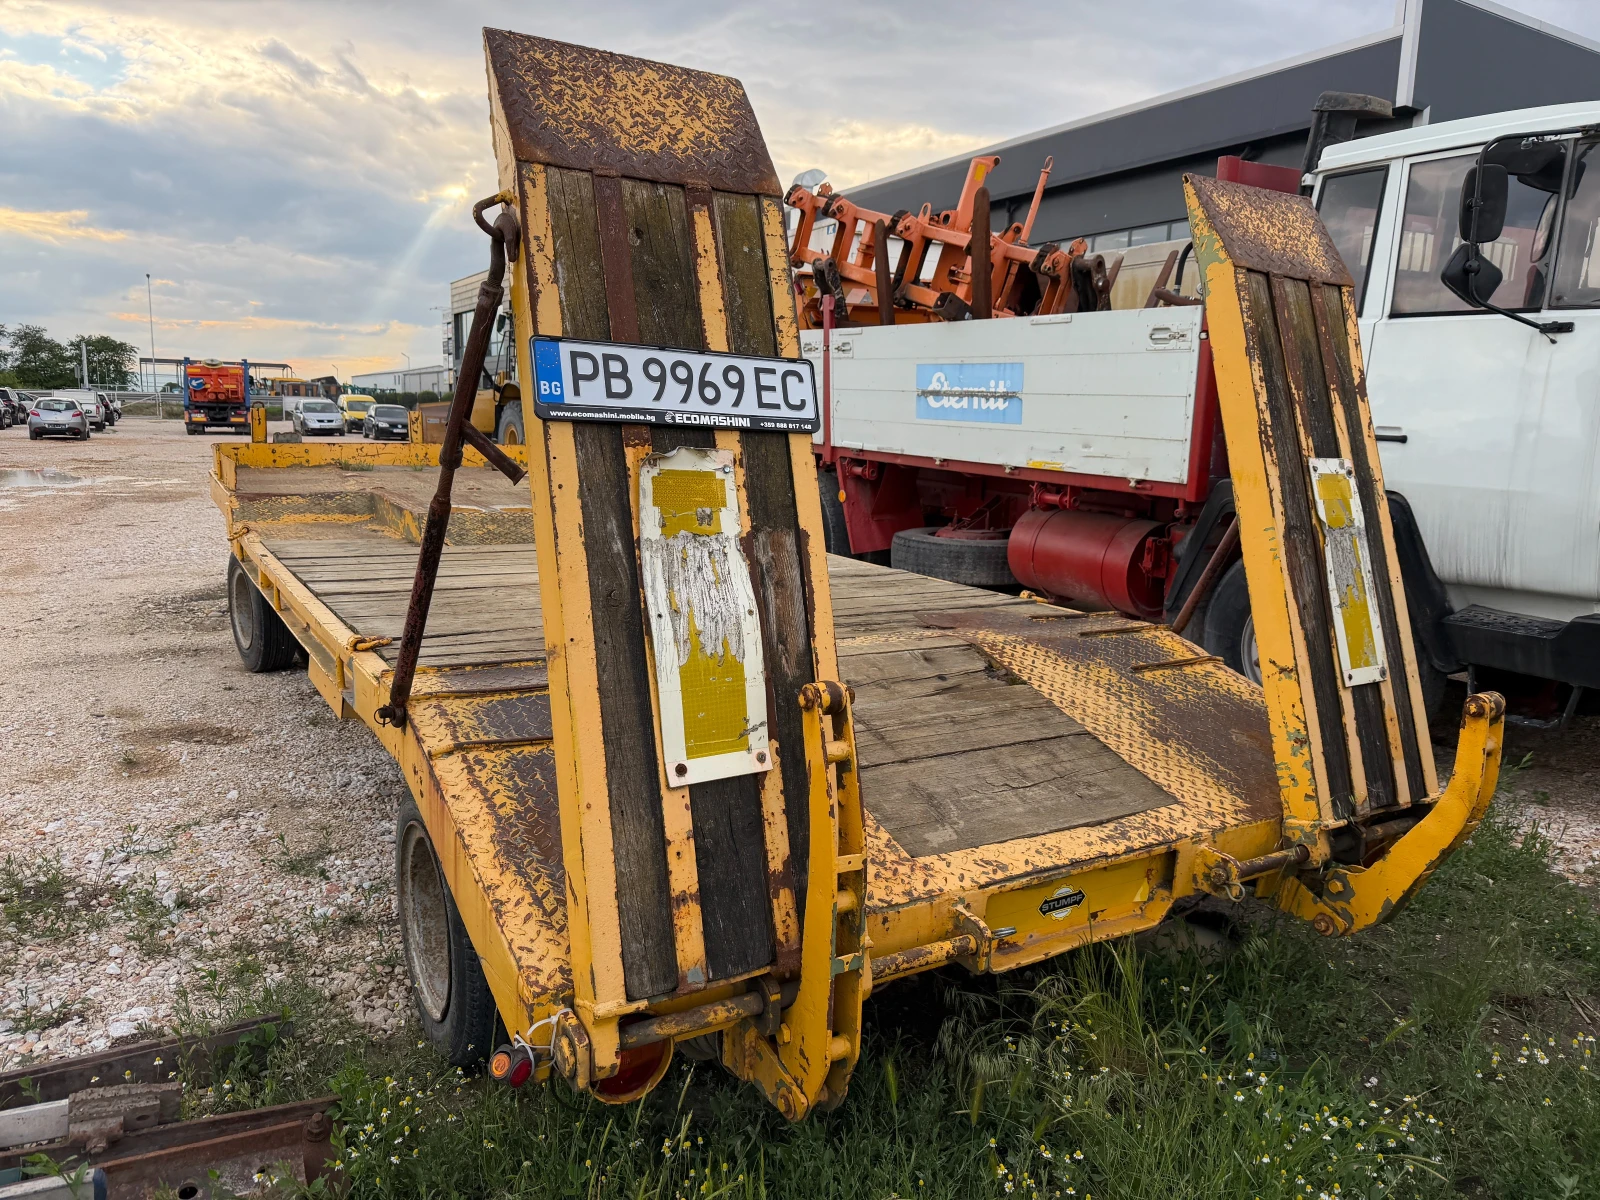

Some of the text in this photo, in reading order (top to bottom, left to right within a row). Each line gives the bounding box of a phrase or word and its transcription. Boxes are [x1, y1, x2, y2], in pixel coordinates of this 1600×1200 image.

[540, 380, 562, 395] BG
[569, 350, 807, 411] PB 9969 EC
[549, 409, 656, 422] www.ecomashini.mobile.bg
[675, 413, 751, 427] ECOMASHINI
[1041, 893, 1083, 912] STUMPF
